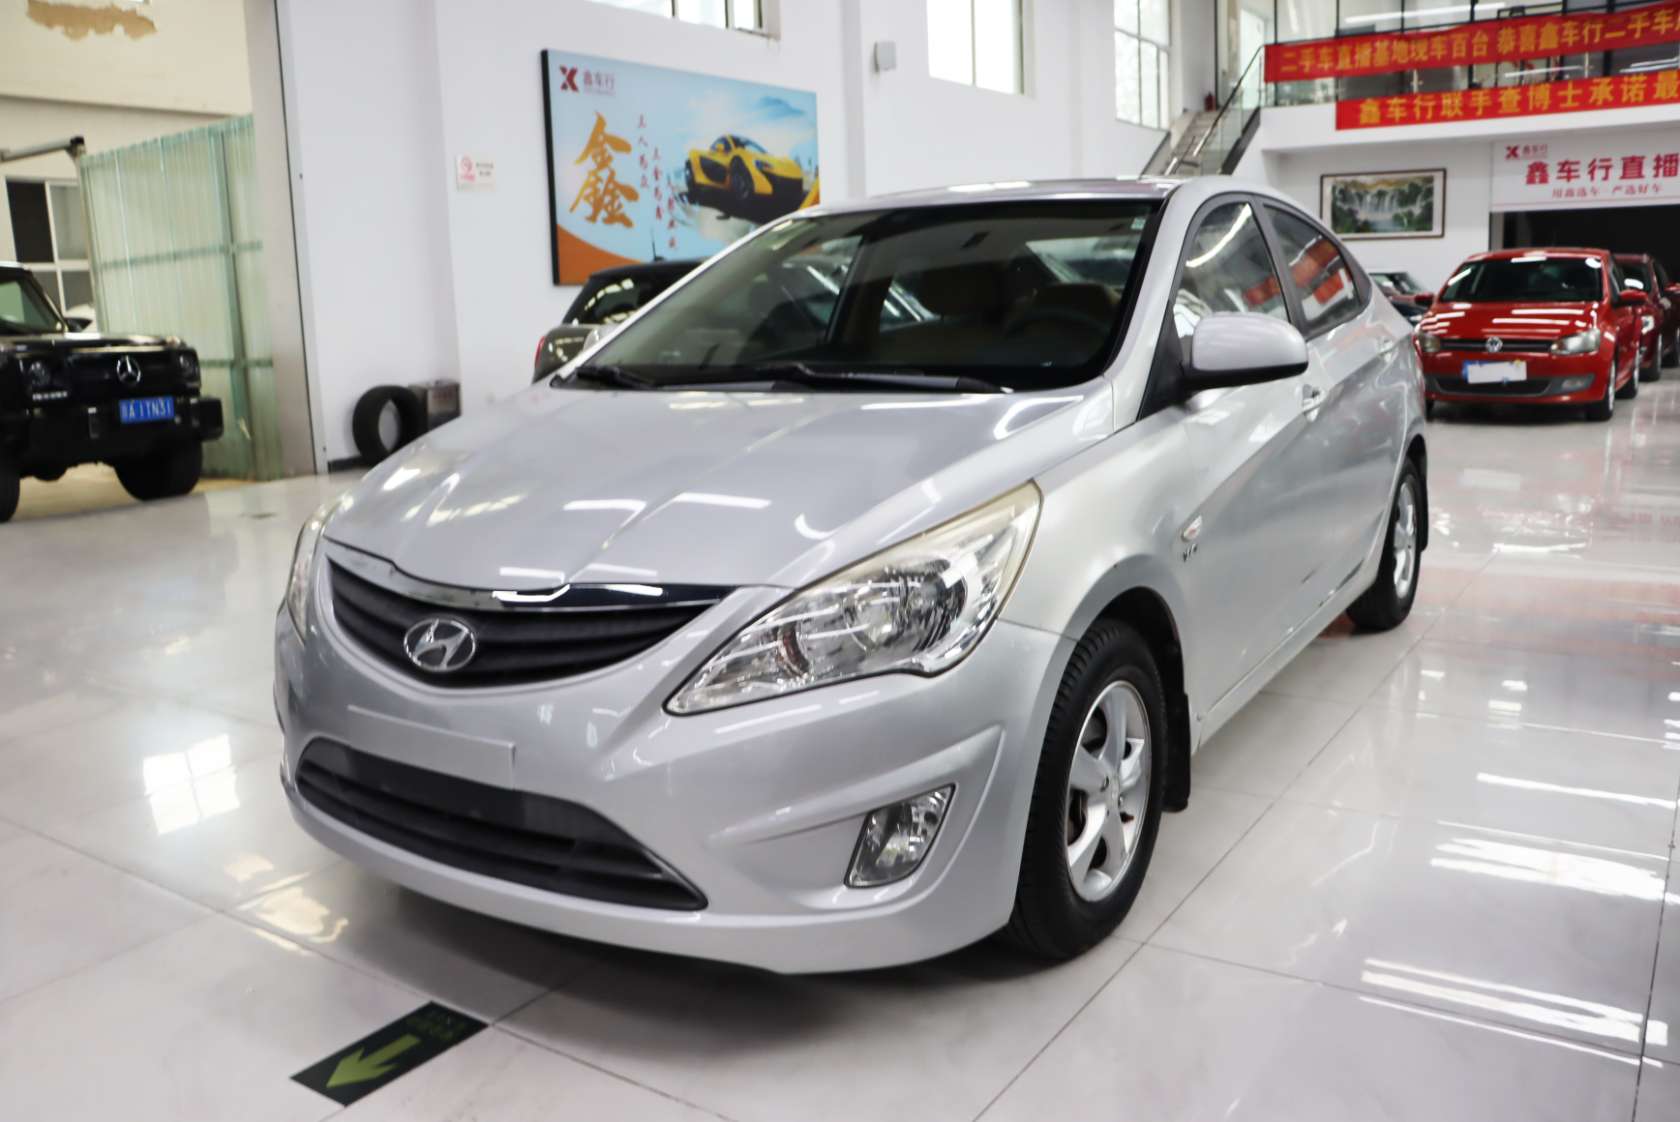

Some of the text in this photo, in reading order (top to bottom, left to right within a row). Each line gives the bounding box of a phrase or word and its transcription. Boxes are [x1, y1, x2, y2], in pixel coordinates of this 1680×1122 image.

[1526, 152, 1680, 185] 鑫车行直播
